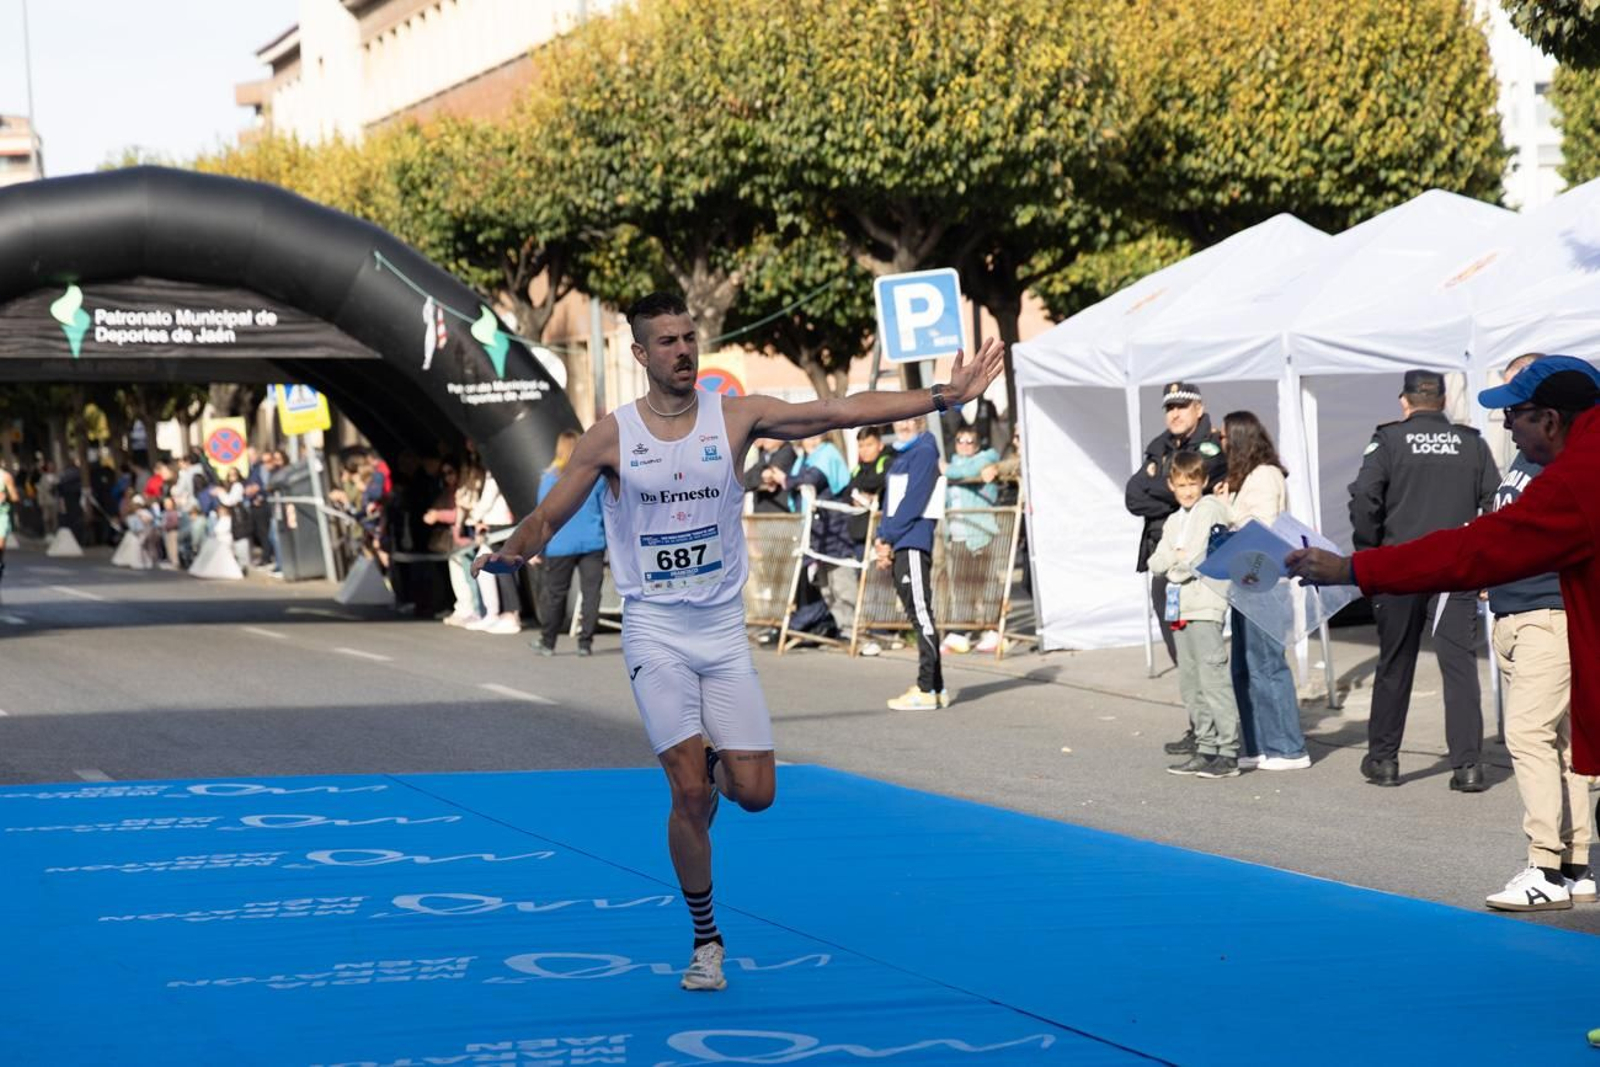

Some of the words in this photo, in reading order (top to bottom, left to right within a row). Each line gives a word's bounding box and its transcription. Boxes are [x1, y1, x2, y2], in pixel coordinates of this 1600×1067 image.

[94, 309, 173, 326] Patronato
[175, 309, 253, 328] Municipal
[255, 309, 278, 326] de
[893, 282, 945, 352] P
[94, 326, 169, 346] Deportes
[171, 327, 193, 343] de
[195, 326, 236, 343] Jaén
[1406, 432, 1462, 445] POLICÍA
[1412, 443, 1459, 454] LOCAL
[640, 492, 657, 503] Da
[660, 486, 720, 503] Ernesto
[657, 544, 707, 570] 687
